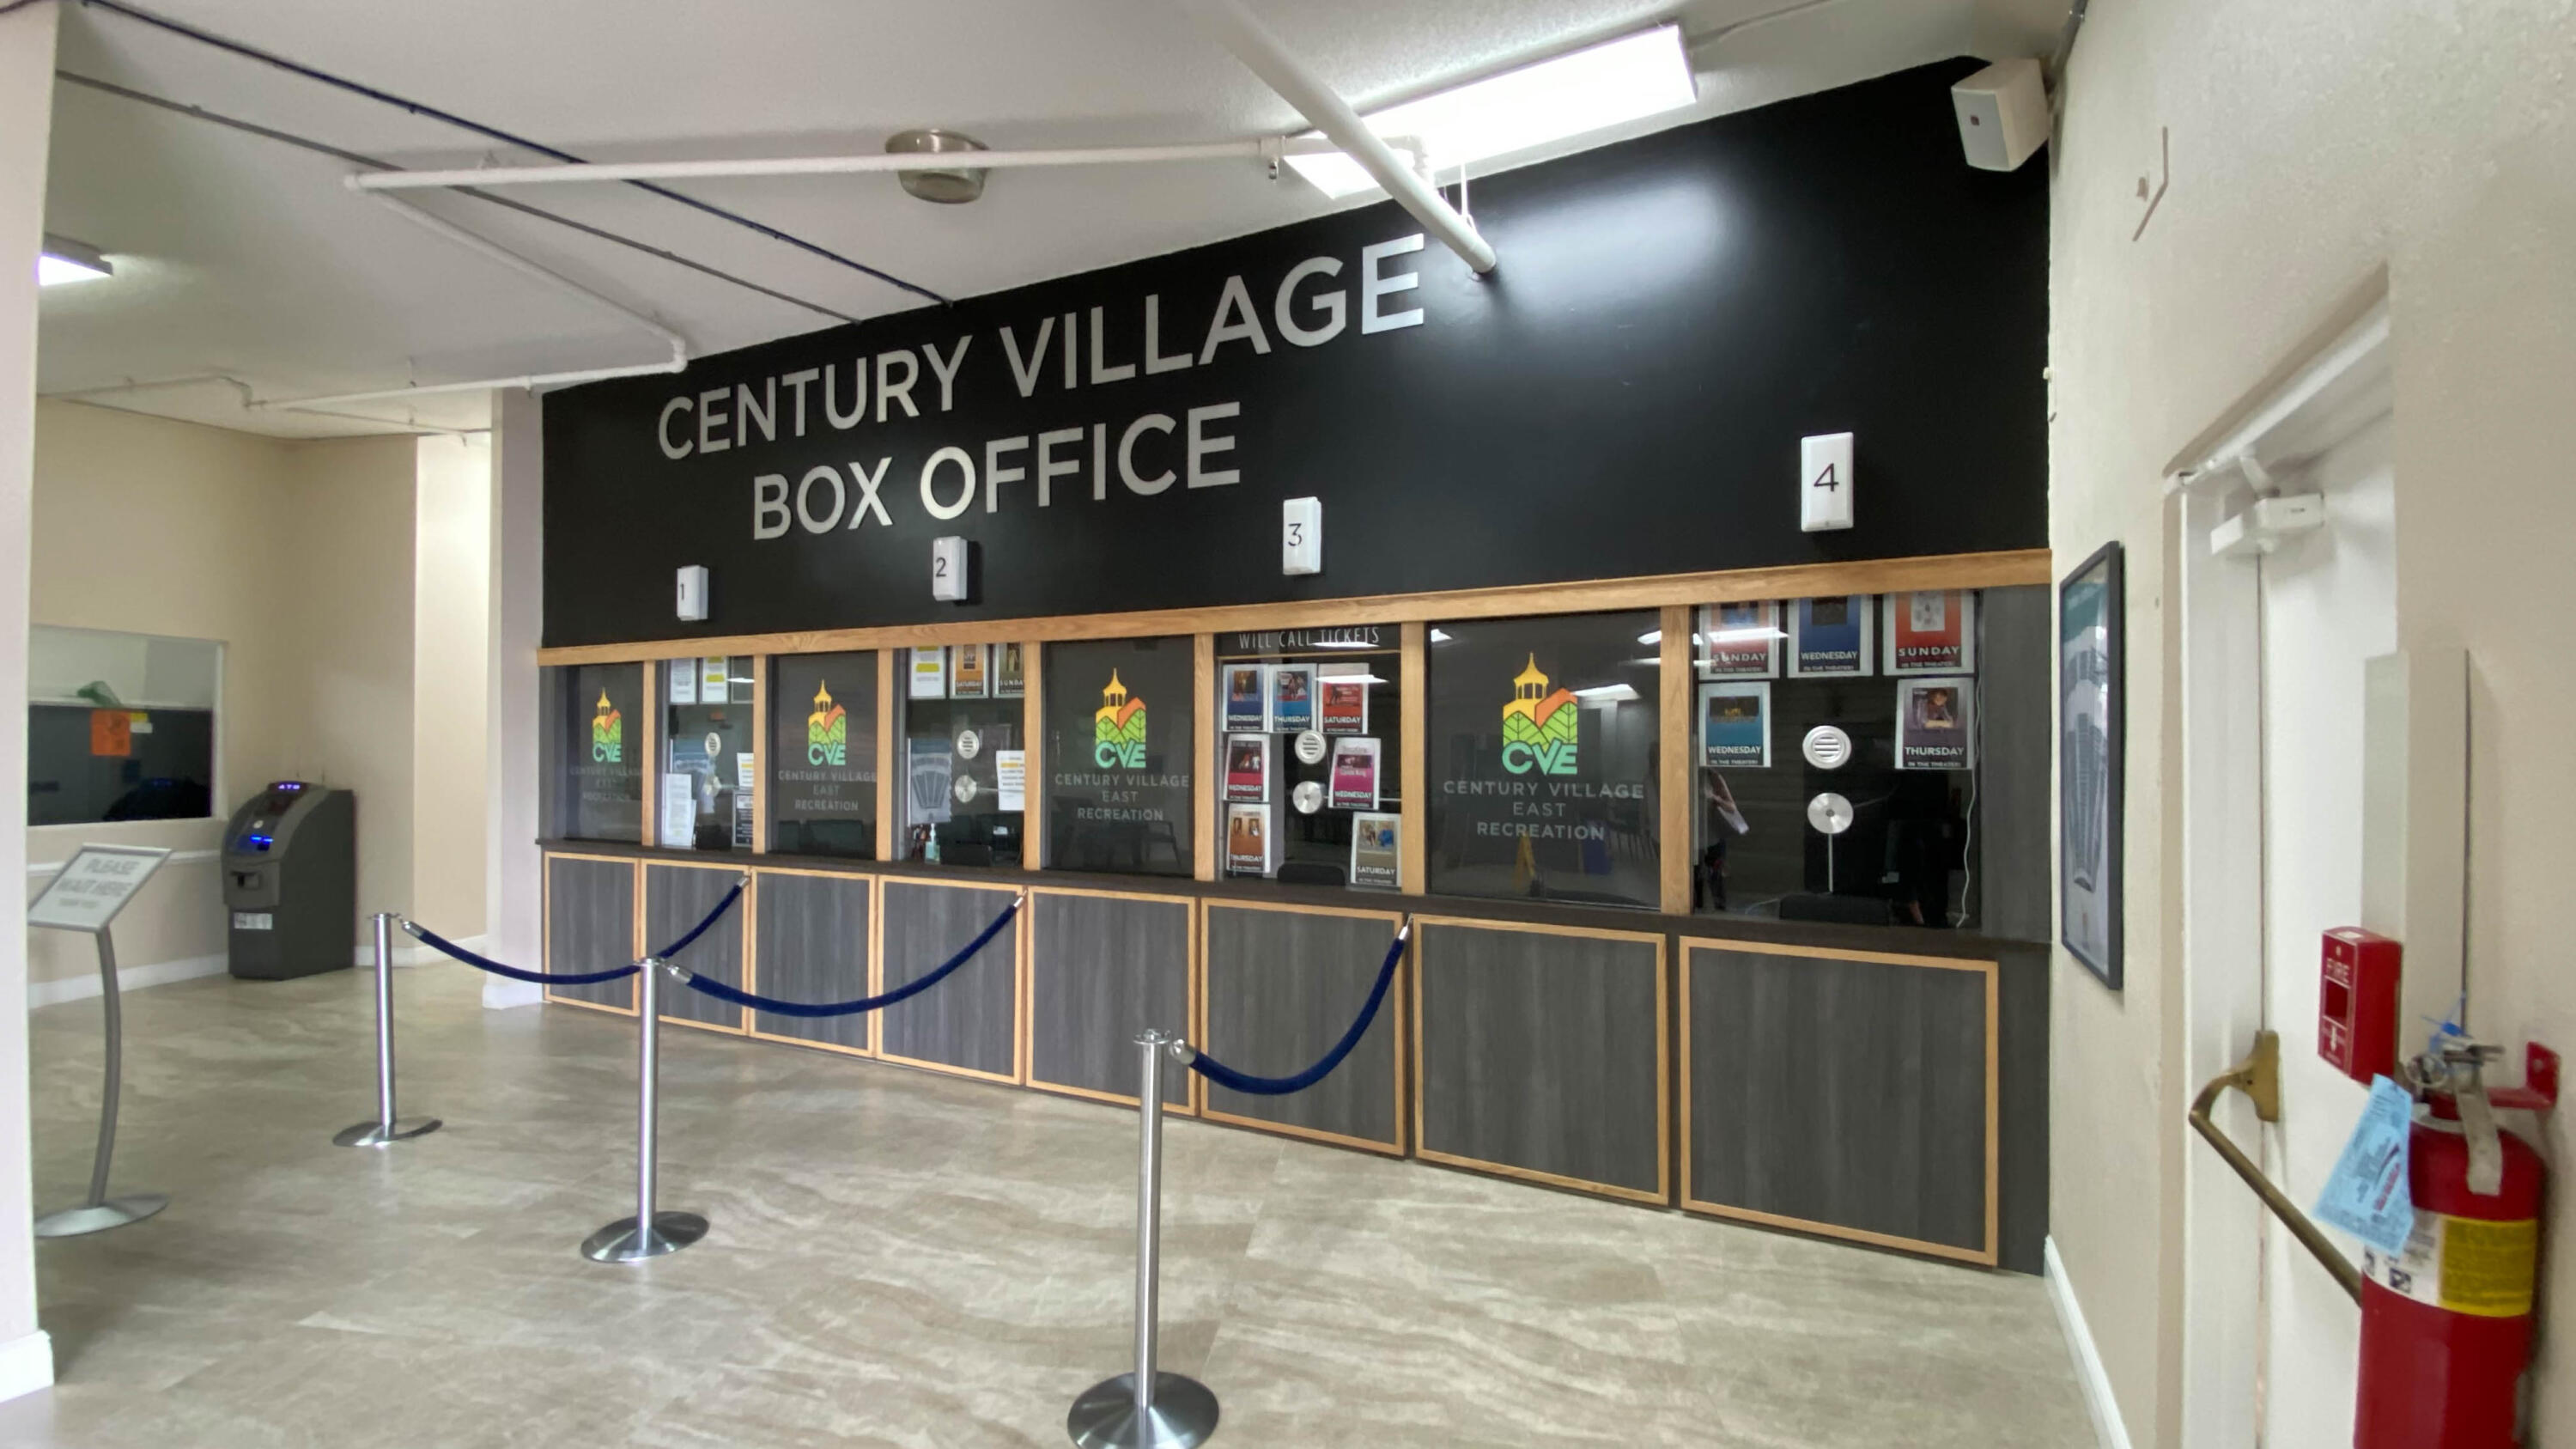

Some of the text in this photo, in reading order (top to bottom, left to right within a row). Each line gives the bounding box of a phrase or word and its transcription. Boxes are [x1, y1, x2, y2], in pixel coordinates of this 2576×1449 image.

[659, 233, 1425, 459] CENTURY VILLAGE
[754, 401, 1241, 539] BOX OFFICE
[1813, 462, 1839, 492] 4
[1287, 523, 1303, 546] 3
[935, 557, 948, 577] 2
[679, 583, 685, 600] 1
[1239, 626, 1380, 649] WILL CALL TICKETS
[1800, 650, 1858, 661] WEDNESDAY
[1898, 646, 1959, 657] SUNDAY
[1274, 715, 1310, 723] THURSDAY
[592, 741, 622, 763] CVE
[808, 740, 846, 765] CVE
[1095, 740, 1146, 769] CVE
[1502, 738, 1578, 776] CVE
[1708, 746, 1761, 755] WEDNESDAY
[1905, 746, 1965, 757] THURSDAY
[778, 770, 826, 782] CENTURY
[1055, 774, 1189, 788] CENTURY VILLAGE
[813, 785, 841, 796] EAST
[1102, 790, 1139, 803] EAST
[1443, 780, 1644, 799] CENTURY VILLAGE
[794, 800, 859, 811] RECREATION
[1078, 807, 1163, 821] RECREATION
[1514, 801, 1566, 817] EAST
[1477, 821, 1604, 840] RECREATION
[1357, 866, 1396, 875] SATURDAY
[2326, 957, 2350, 984] FIRE
